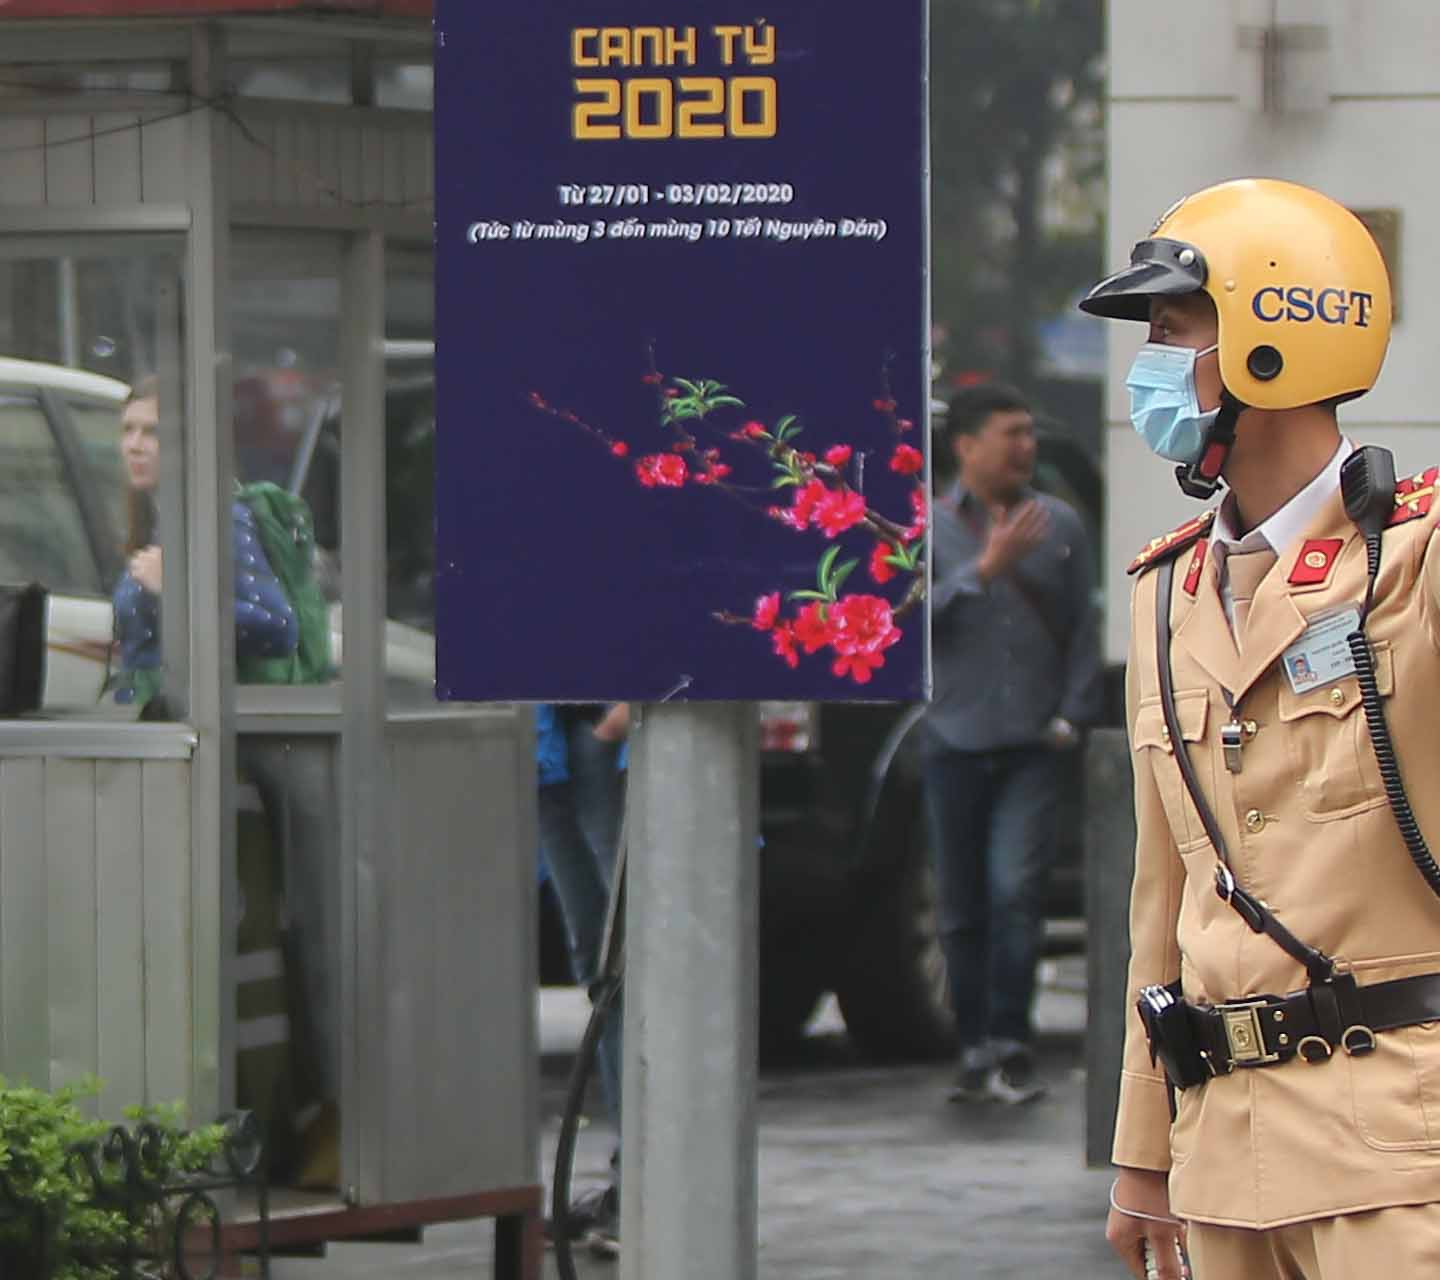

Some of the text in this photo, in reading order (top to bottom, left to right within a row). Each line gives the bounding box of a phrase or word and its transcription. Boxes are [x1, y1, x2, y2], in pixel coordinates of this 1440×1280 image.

[573, 17, 777, 68] CANH TÝ
[573, 75, 778, 141] 2020
[558, 183, 586, 205] Từ
[588, 184, 649, 207] 27/01
[668, 184, 794, 206] 03/02/2020
[469, 217, 888, 244] (Tức từ mùng 3 đến mùng 10 Tết Nguyên Đán)
[1251, 286, 1373, 329] CSGT
